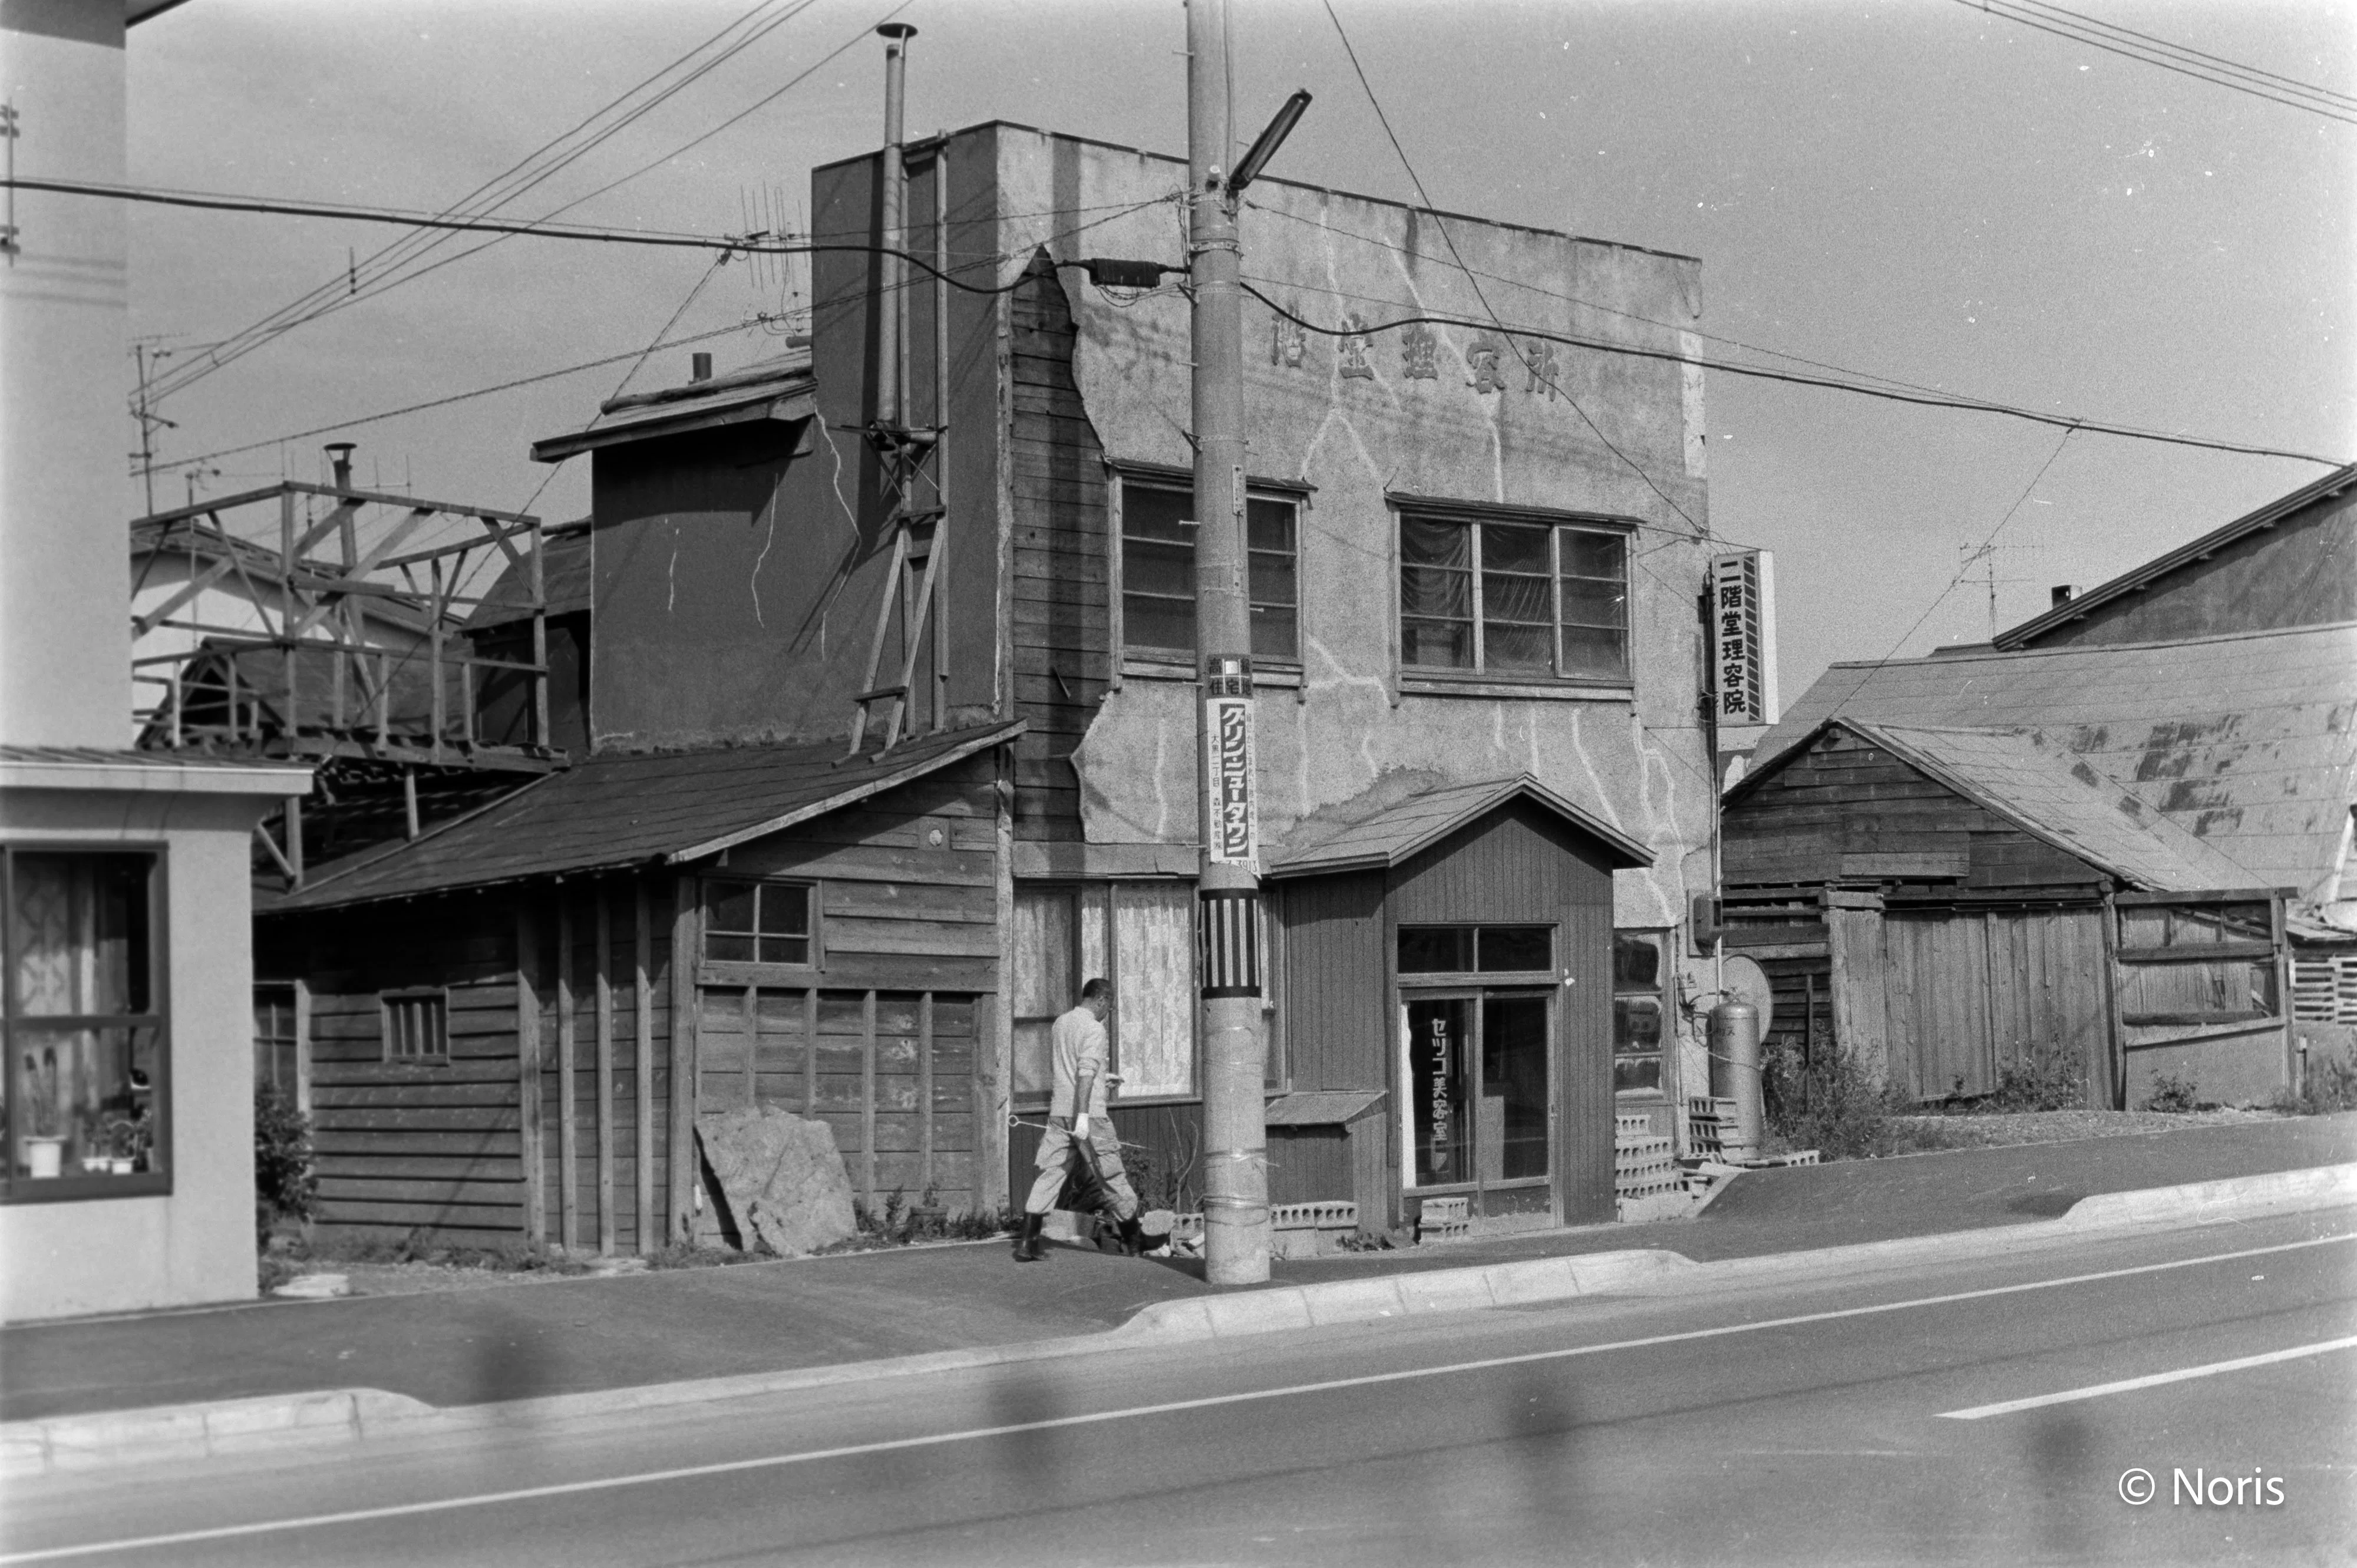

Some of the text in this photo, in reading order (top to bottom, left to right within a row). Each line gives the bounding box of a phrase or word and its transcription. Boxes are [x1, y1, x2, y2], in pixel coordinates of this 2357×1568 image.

[1209, 679, 1251, 695] 住宅地
[1719, 560, 1747, 715] 二階堂理容院
[1431, 1018, 1448, 1141] セツコ美容室
